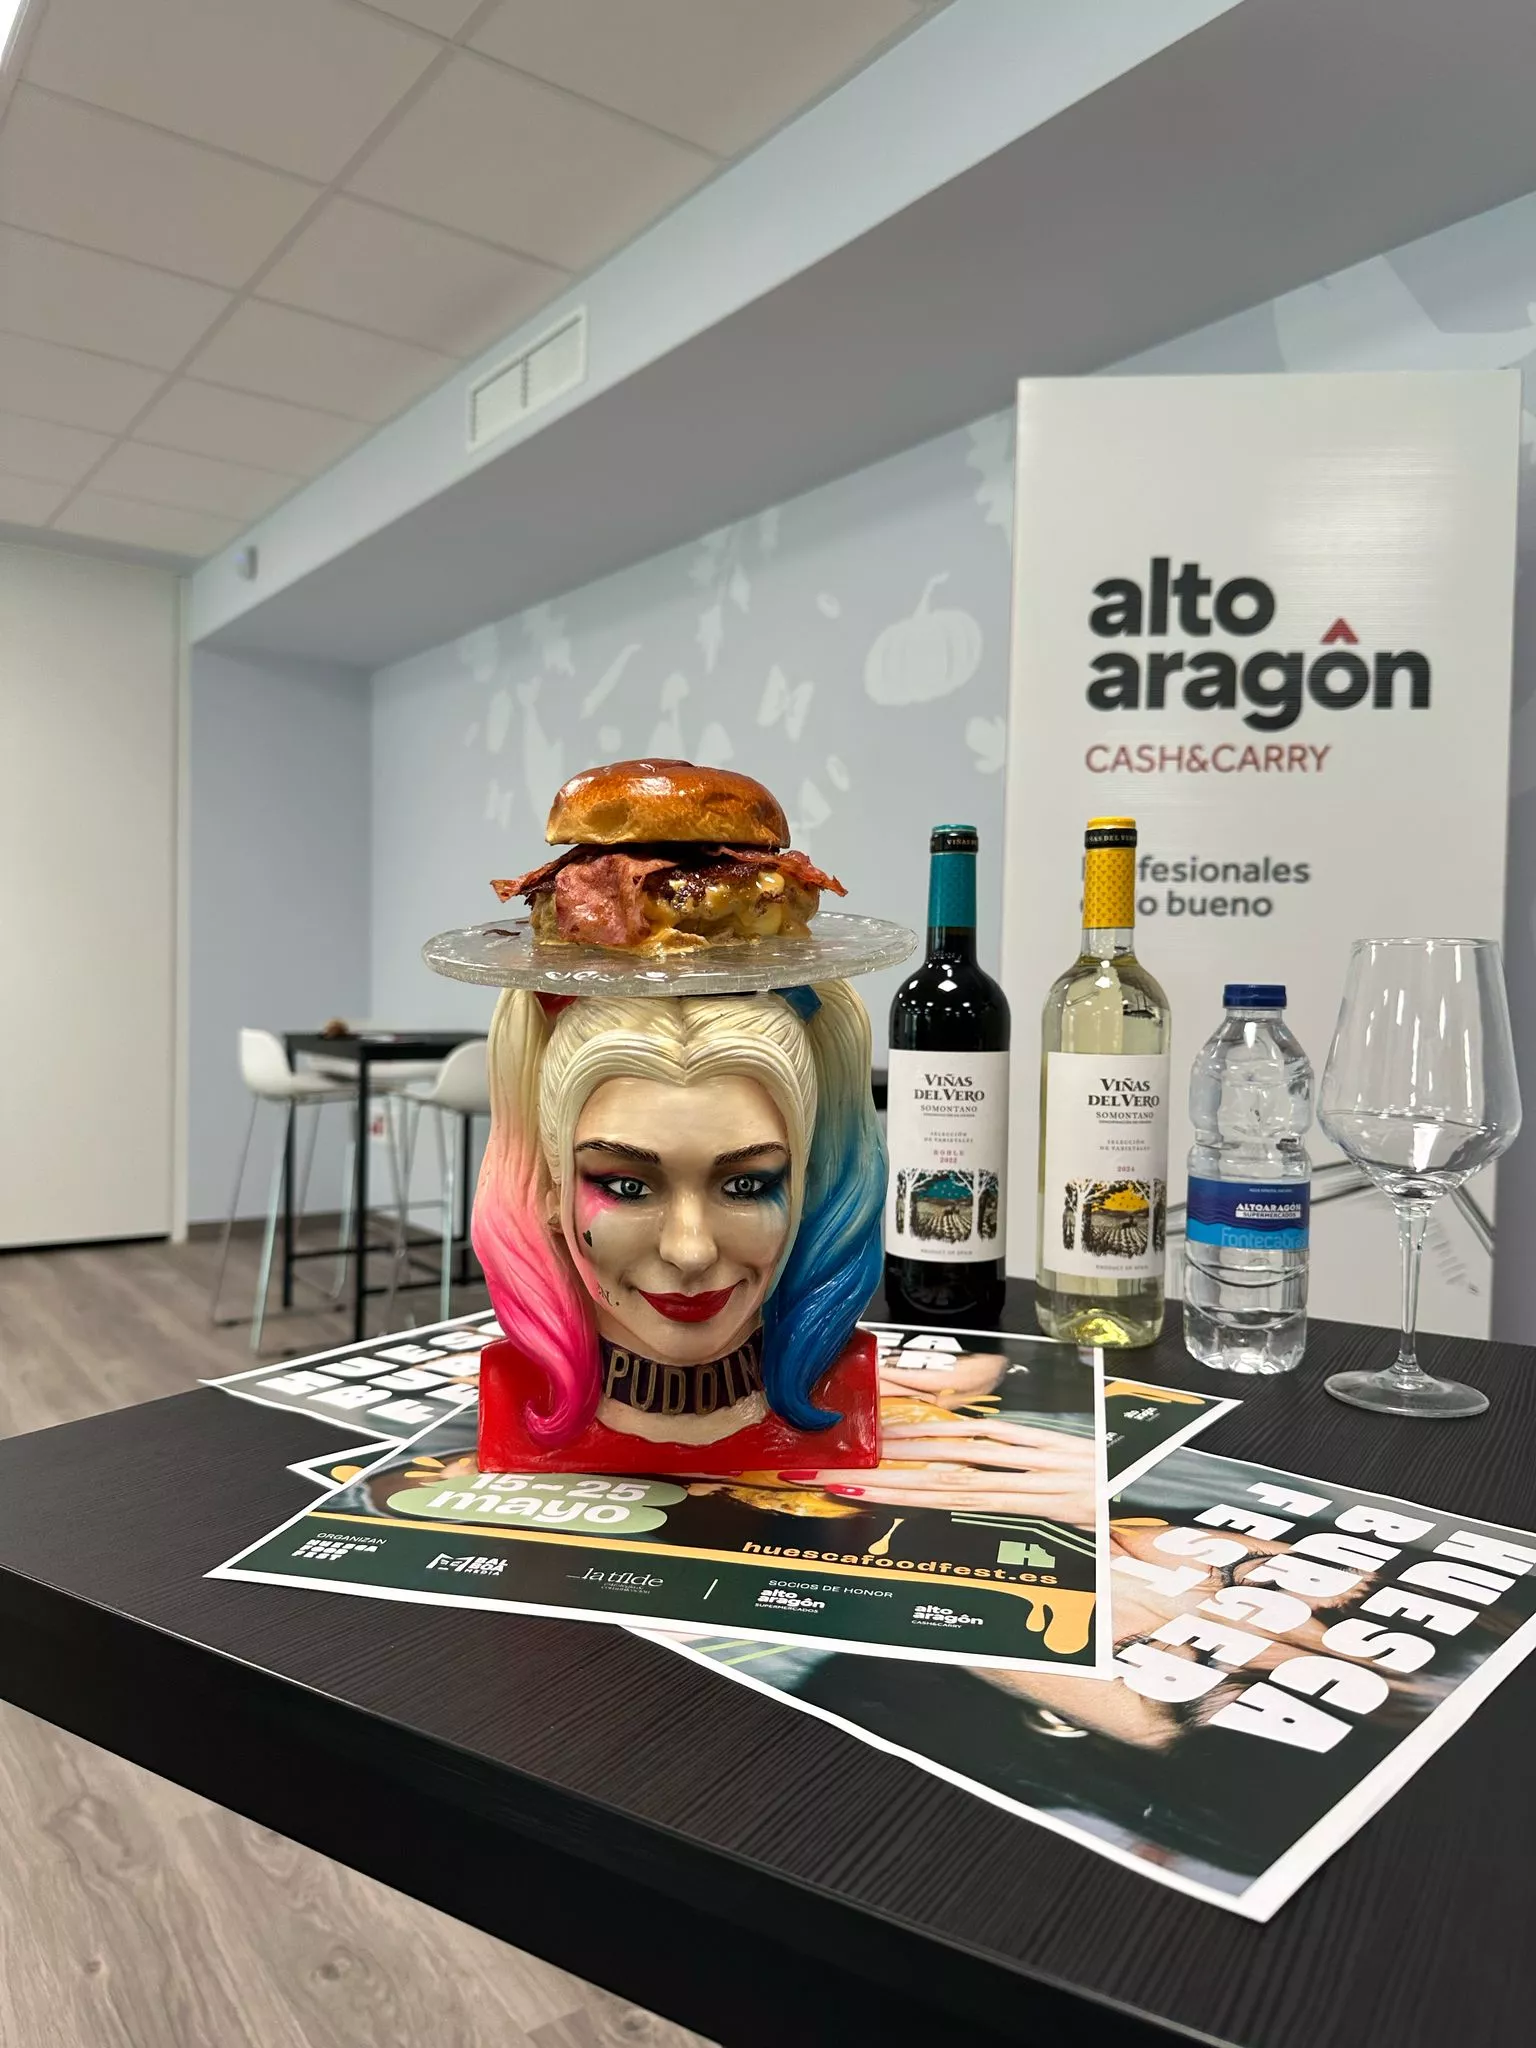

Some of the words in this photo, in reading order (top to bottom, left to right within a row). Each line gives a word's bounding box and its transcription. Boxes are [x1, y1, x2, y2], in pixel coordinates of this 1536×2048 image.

[1087, 556, 1276, 637] alto
[1085, 744, 1331, 773] CASH&CARRY
[1082, 855, 1310, 883] fesionales
[1166, 889, 1273, 917] bueno
[920, 1104, 978, 1113] SOMONTANO
[1096, 1111, 1154, 1119] SOMONTANO
[605, 1344, 761, 1415] PUDDIN
[426, 1490, 630, 1524] mayo
[317, 1533, 387, 1545] ORGANIZAN
[1110, 1482, 1333, 1598] FEST
[742, 1541, 1060, 1585] huescafoodfest.es
[760, 1588, 798, 1599] alto
[768, 1579, 818, 1591] SOCIOS
[844, 1587, 893, 1598] HONOR
[755, 1603, 819, 1614] SUPERMERCADOS
[914, 1604, 953, 1615] alto
[1112, 1505, 1437, 1703] BURGER
[911, 1620, 962, 1629] CASH&CARRY
[1208, 1530, 1536, 1754] HUESCA
